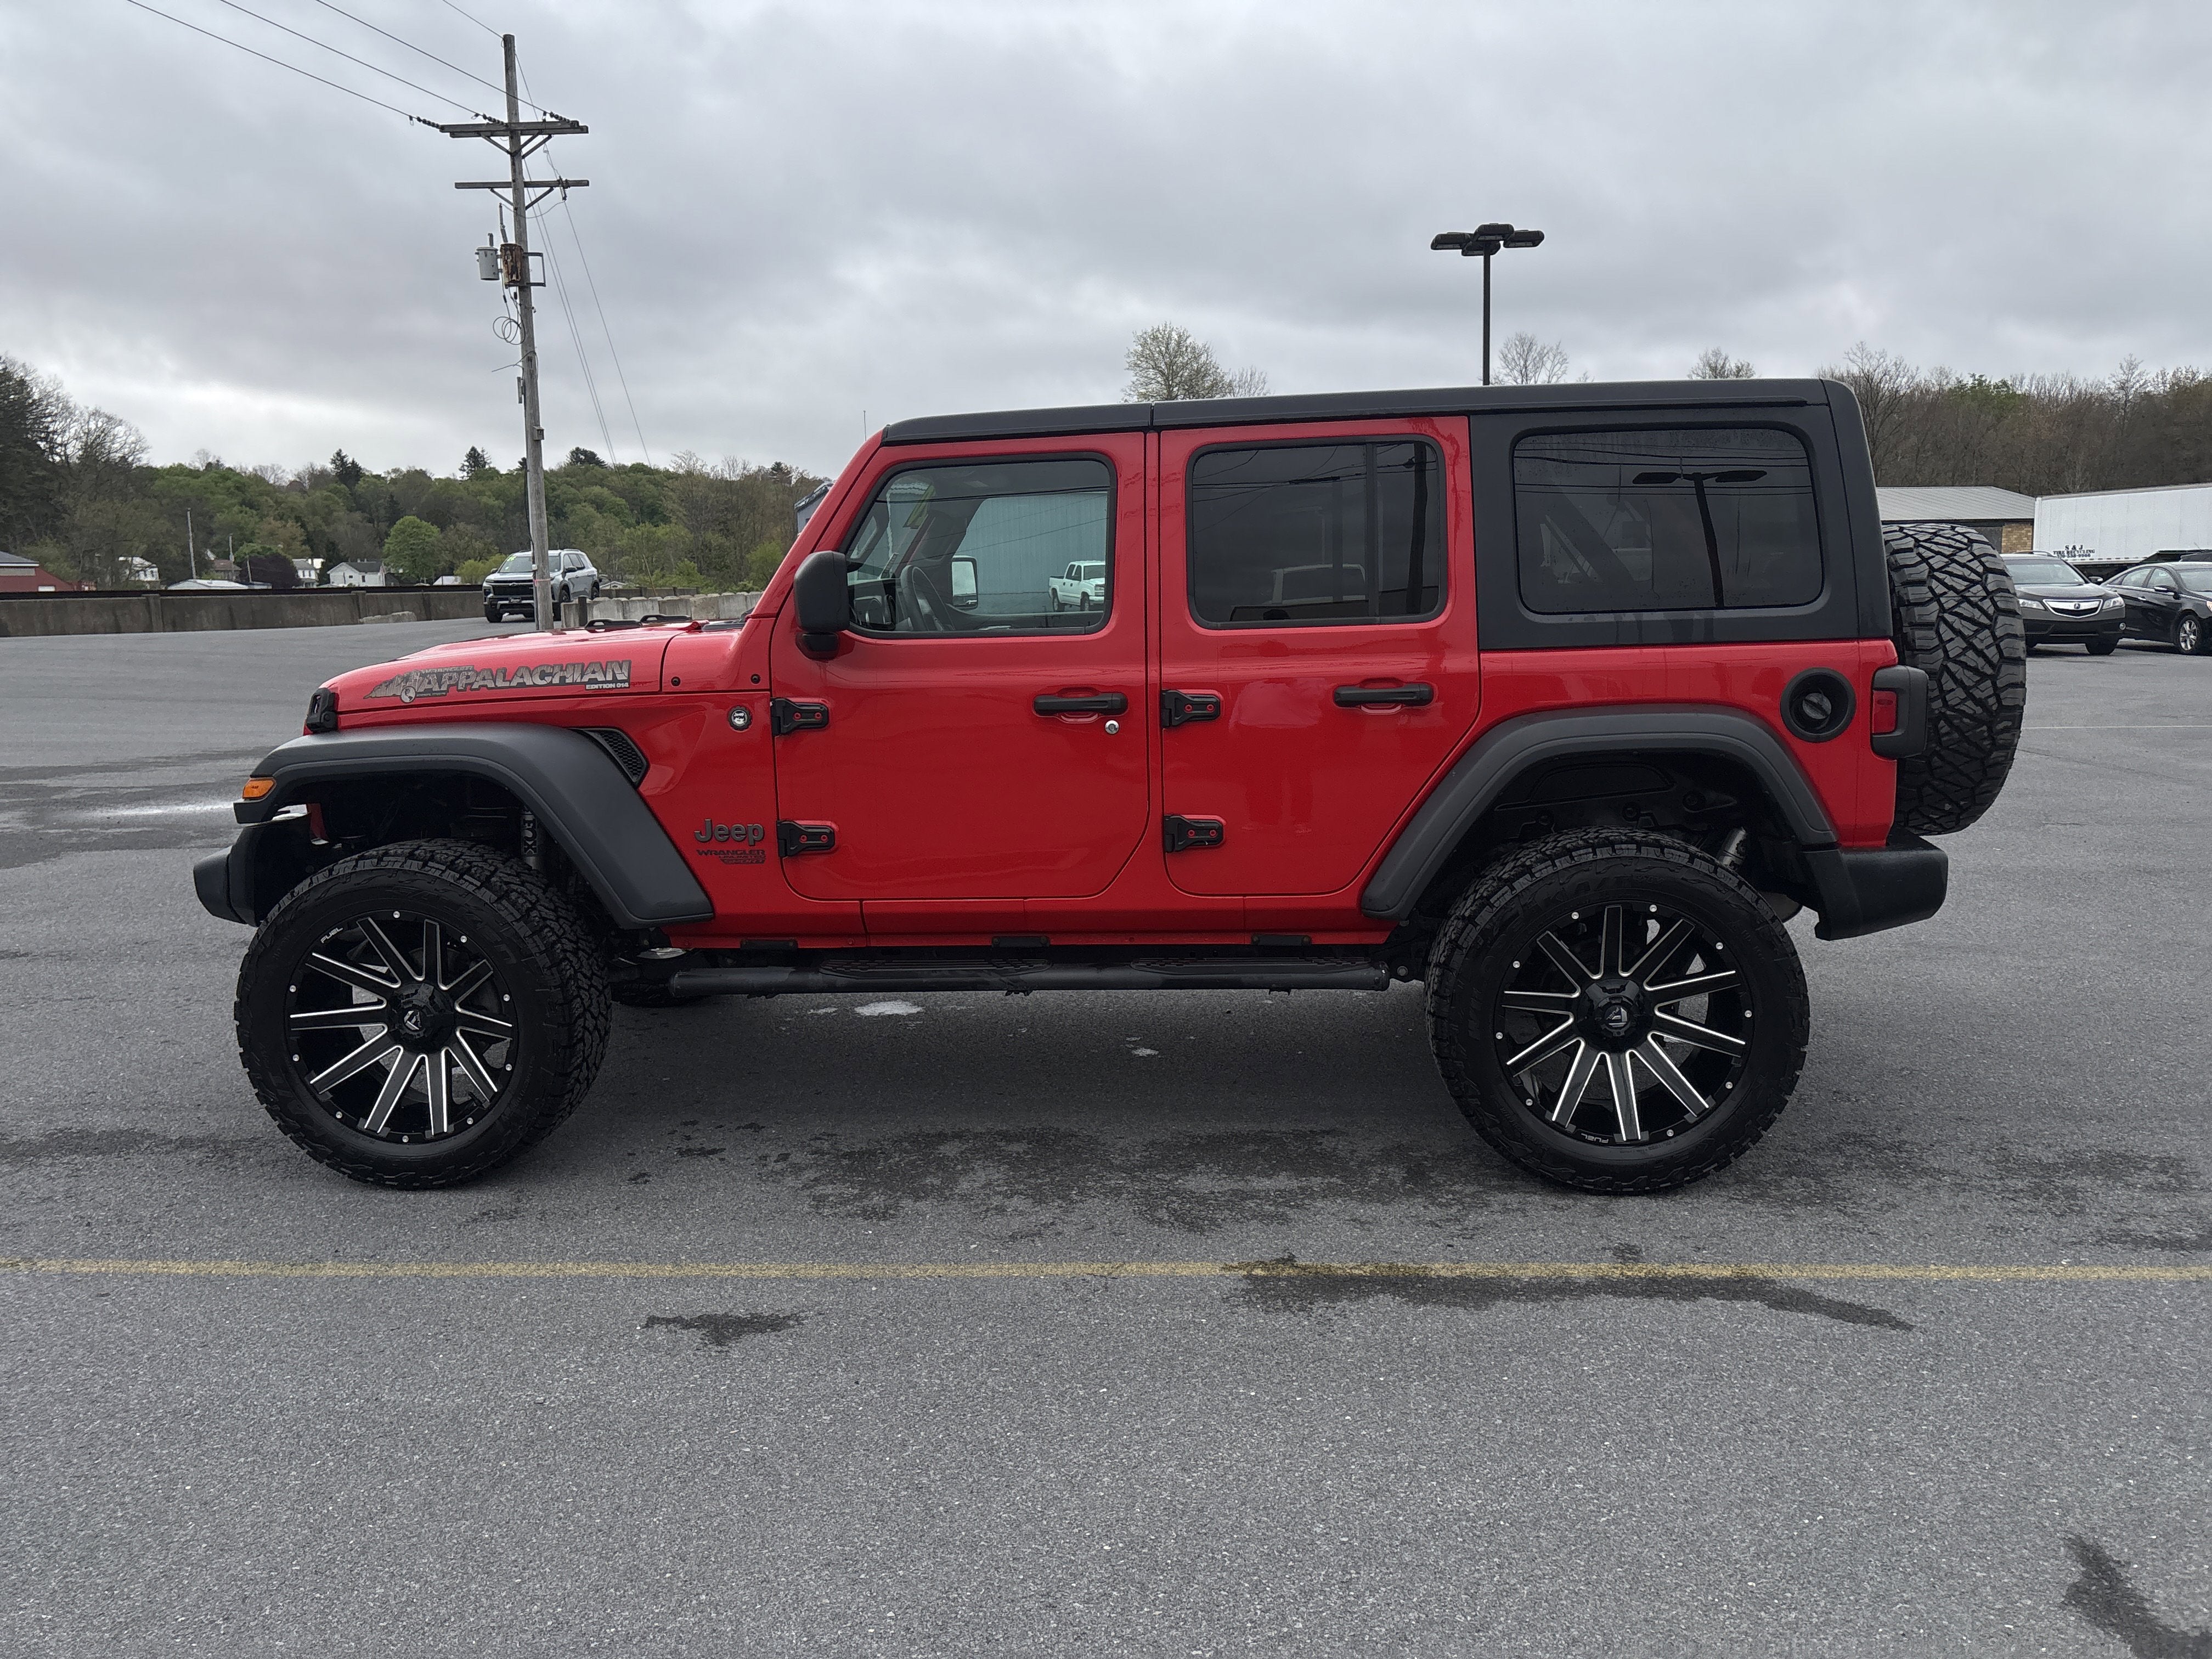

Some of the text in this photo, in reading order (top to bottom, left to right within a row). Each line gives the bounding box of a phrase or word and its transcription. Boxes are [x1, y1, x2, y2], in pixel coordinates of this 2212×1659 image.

[415, 661, 630, 692] APPALACHIAN
[694, 818, 765, 846] Jeep
[320, 927, 343, 944] FUEL
[1581, 1132, 1609, 1143] FUEL
